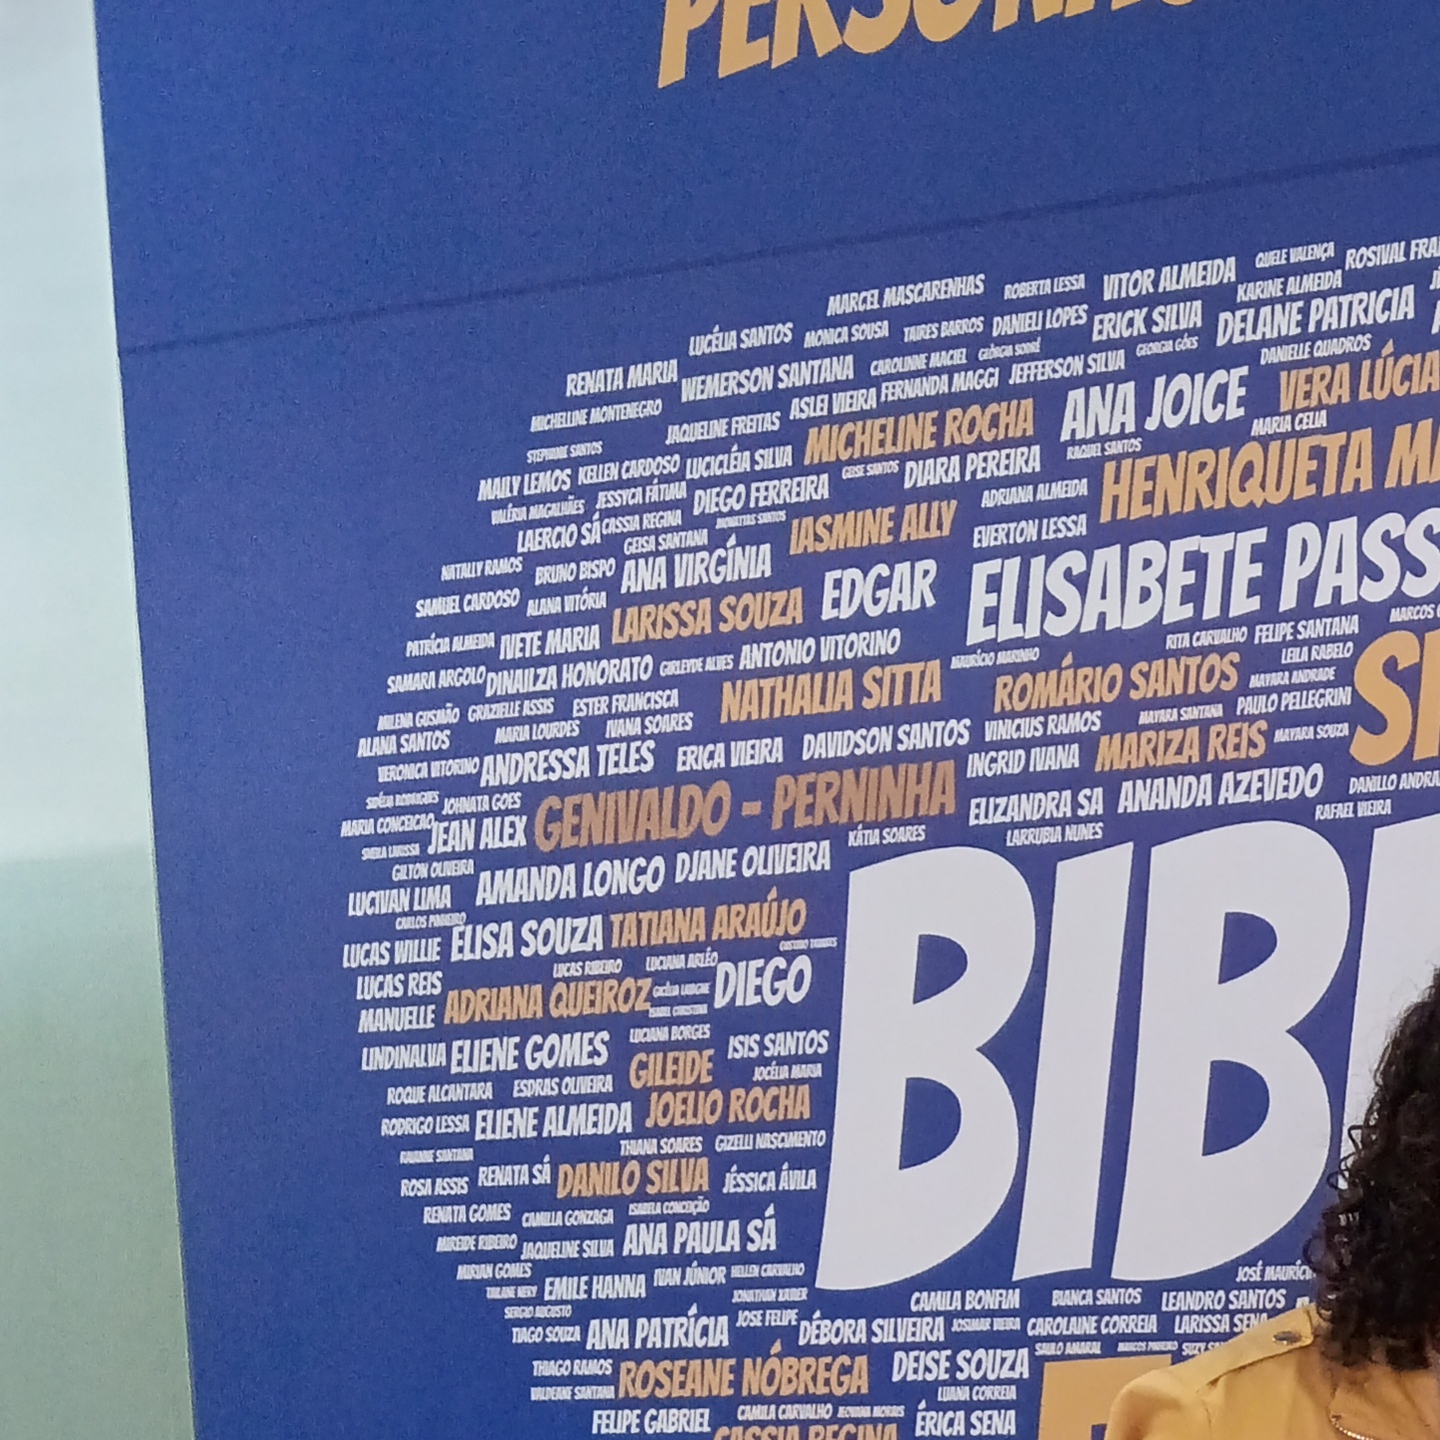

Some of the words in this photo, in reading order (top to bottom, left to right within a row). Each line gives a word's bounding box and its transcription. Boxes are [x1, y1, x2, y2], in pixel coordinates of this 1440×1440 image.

[1217, 301, 1304, 346] DELANE
[1308, 285, 1414, 333] PATRICIA
[566, 367, 623, 397] RENATA
[627, 359, 677, 388] MARIA
[1060, 381, 1135, 442] ANA
[1144, 366, 1248, 431] JOICE
[1280, 364, 1350, 412] VERA
[1359, 339, 1440, 401] LÚCIA
[804, 411, 938, 465] MICHELINE
[944, 398, 1033, 447] ROCHA
[1100, 428, 1372, 523] HENRIQUETA
[621, 556, 667, 593] ANA
[675, 543, 771, 588] VIRGÍNIA
[821, 559, 937, 620] EDGAR
[966, 522, 1268, 649] ELISABETE
[612, 598, 711, 644] LARISSA
[719, 587, 803, 632] SOUZA
[720, 669, 853, 723] NATHALIA
[862, 659, 941, 709] SITTA
[994, 649, 1123, 713] ROMÁRIO
[1130, 652, 1240, 700] SANTOS
[1095, 726, 1199, 772] MARIZA
[1207, 720, 1267, 762] REIS
[535, 780, 731, 852] GENIVALDO
[772, 760, 955, 829] PERNINHA
[610, 907, 705, 948] TATIANA
[712, 886, 806, 940] ARAÚJO
[444, 984, 543, 1024] ADRIANA
[549, 977, 657, 1018] QUEIROZ
[714, 955, 812, 1008] DIEGO
[557, 1160, 640, 1198] DANILO
[646, 1157, 709, 1194] SILVA
[586, 1318, 629, 1350] ANA
[635, 1303, 729, 1349] PATRÍCIA
[619, 1358, 736, 1398] ROSEANE
[742, 1339, 868, 1396] NÓBREGA
